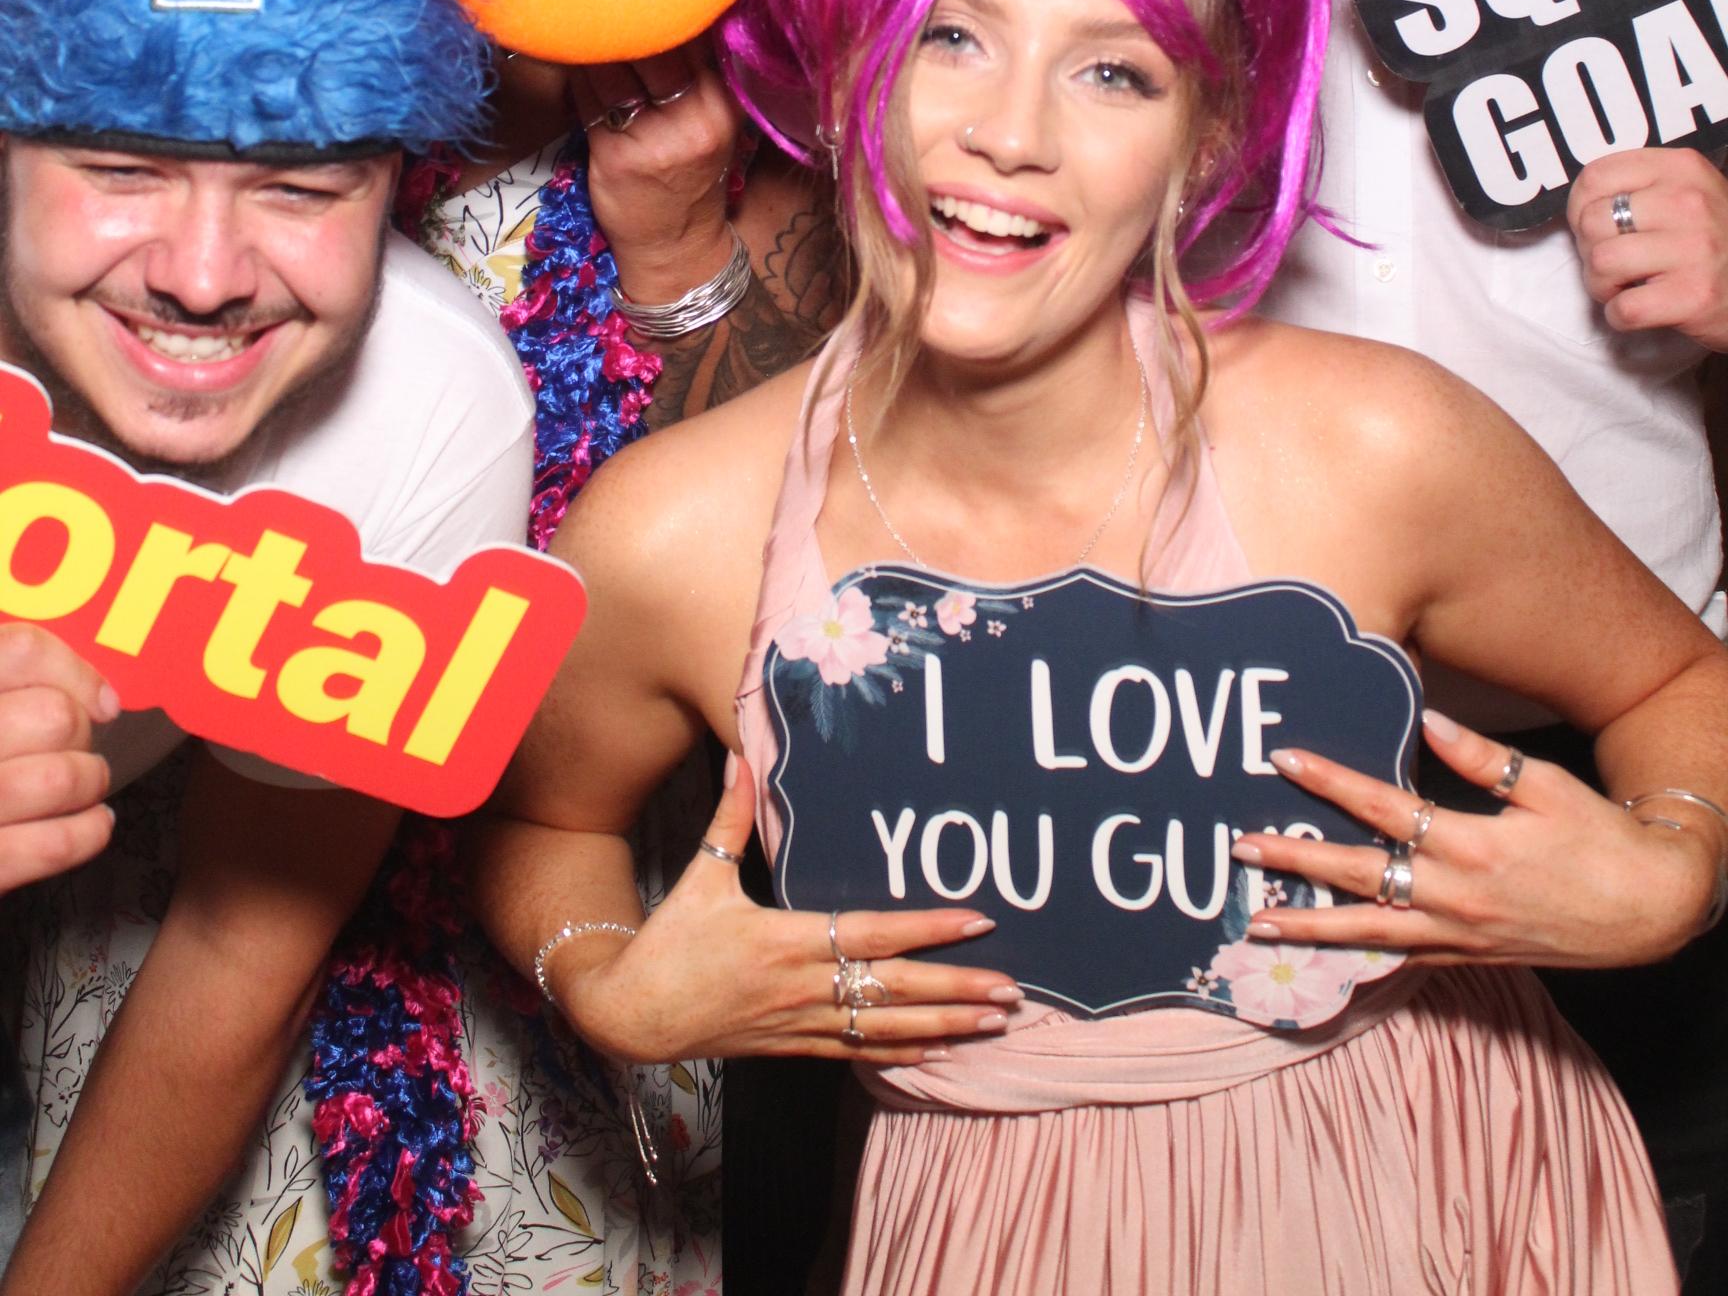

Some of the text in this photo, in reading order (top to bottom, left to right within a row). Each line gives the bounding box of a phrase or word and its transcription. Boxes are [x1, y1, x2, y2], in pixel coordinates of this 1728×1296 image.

[0, 481, 530, 766] ortal
[925, 653, 1290, 777] I LOVE
[871, 807, 1054, 910] YOU
